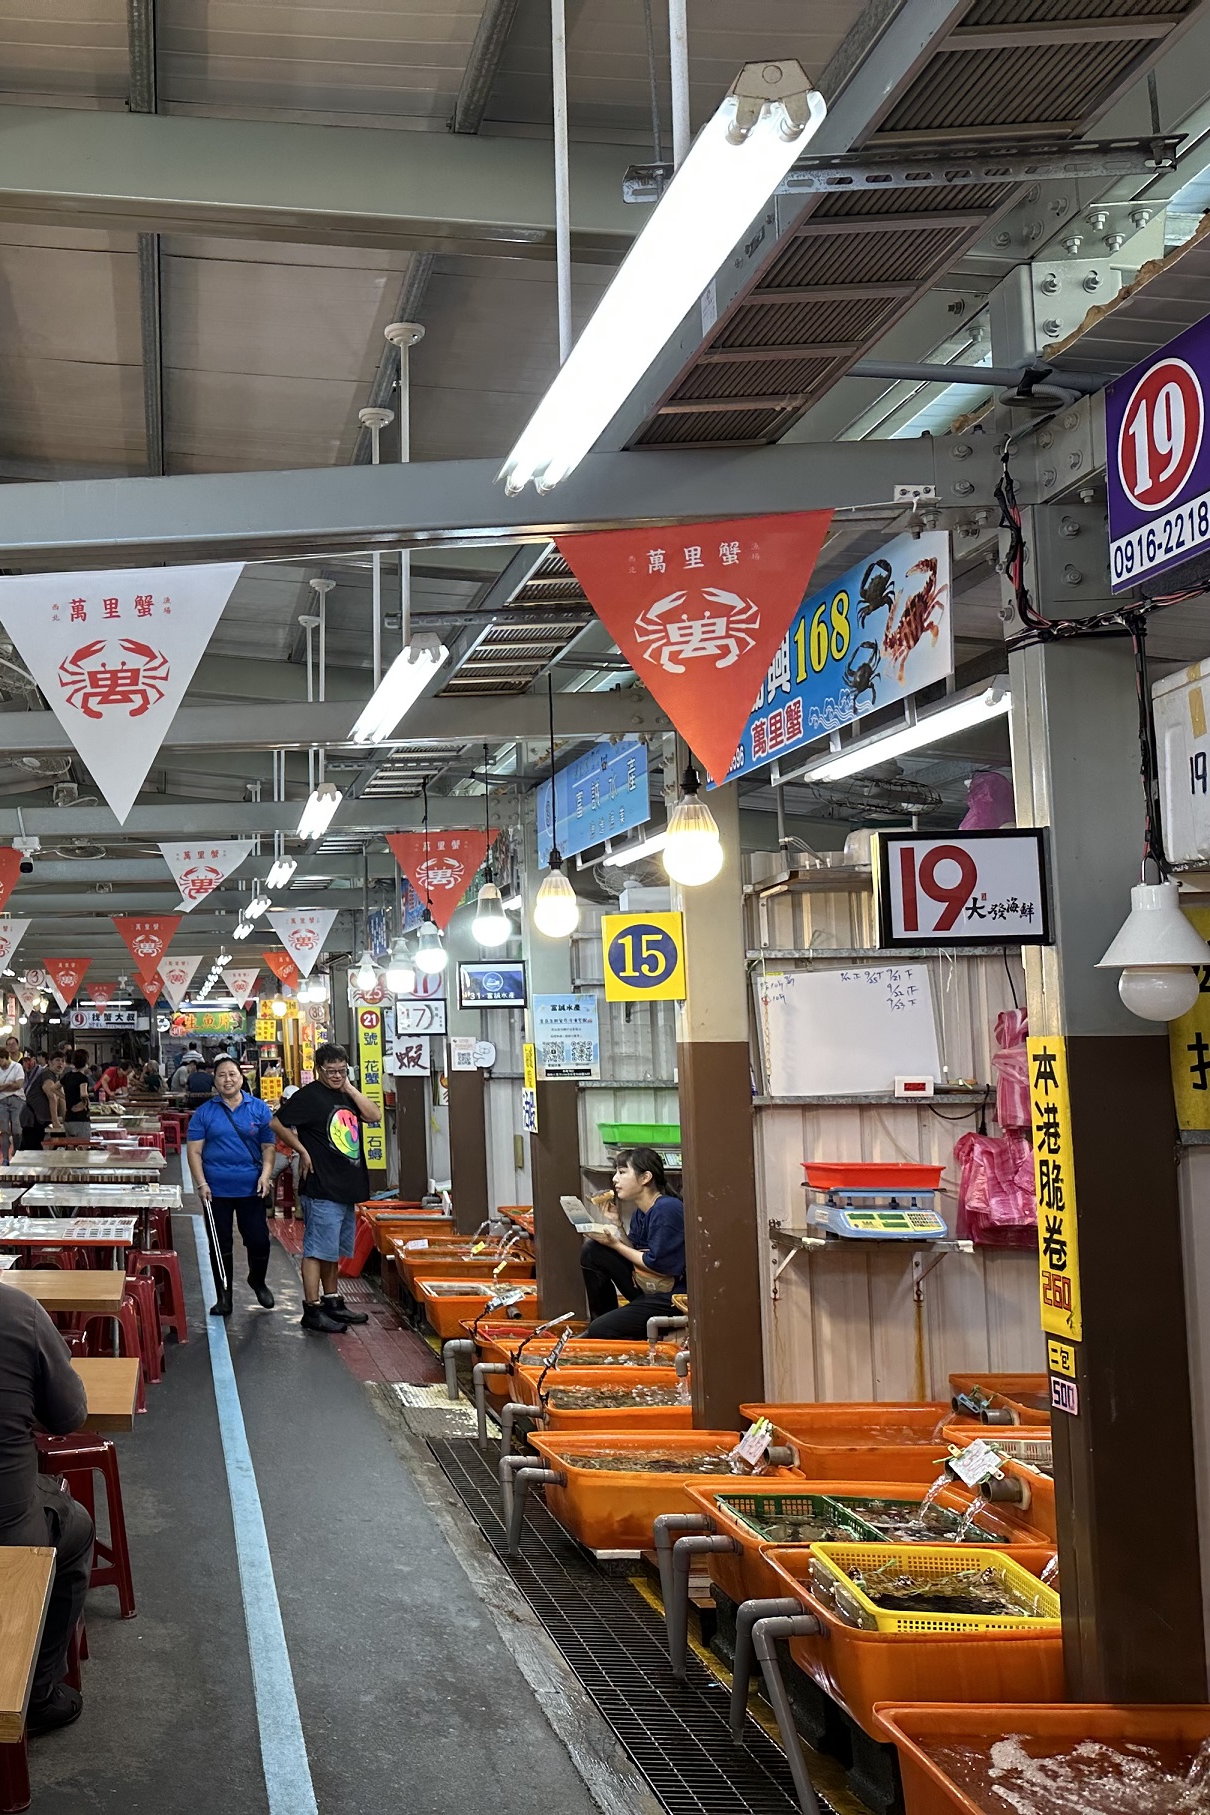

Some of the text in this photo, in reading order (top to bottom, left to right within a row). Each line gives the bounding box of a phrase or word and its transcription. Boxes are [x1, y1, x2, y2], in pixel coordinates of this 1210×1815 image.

[1129, 382, 1186, 496] 19
[647, 541, 742, 574] 萬里蟹
[1114, 500, 1210, 579] 0916-2218
[69, 594, 155, 622] 萬里蟹
[794, 590, 851, 685] 168
[751, 697, 804, 762] 萬里蟹
[183, 849, 220, 861] 萬里蟹
[899, 845, 1035, 932] 19 大發海鮮
[617, 934, 666, 977] 15
[363, 1014, 377, 1026] 21
[1032, 1045, 1069, 1272] 本港脆卷
[1042, 1270, 1072, 1312] 260
[1050, 1346, 1070, 1371] 二包
[1052, 1380, 1075, 1411] 500
